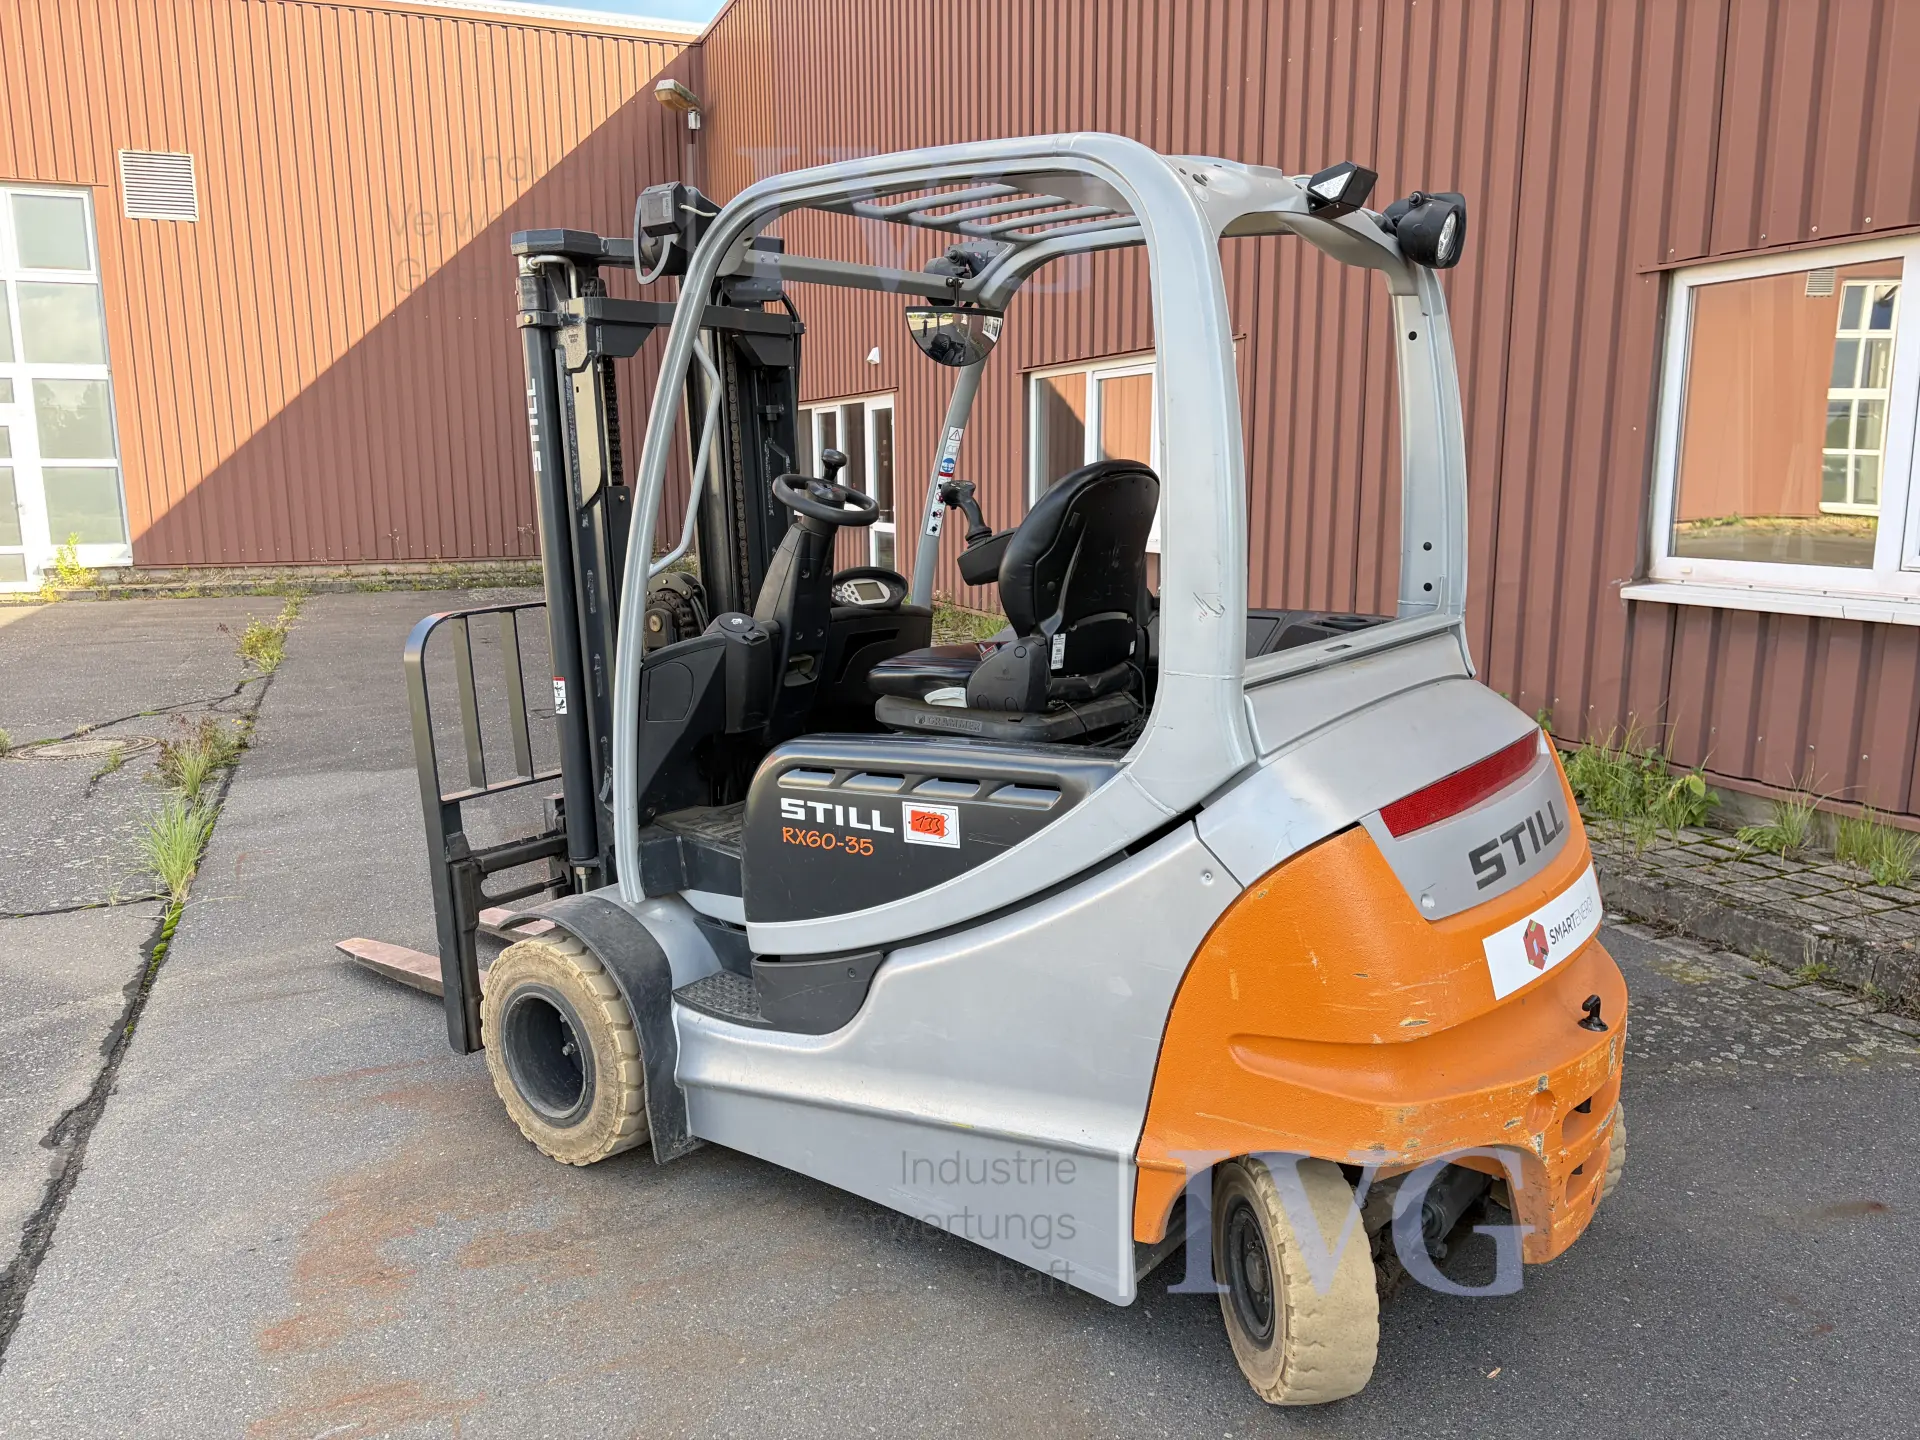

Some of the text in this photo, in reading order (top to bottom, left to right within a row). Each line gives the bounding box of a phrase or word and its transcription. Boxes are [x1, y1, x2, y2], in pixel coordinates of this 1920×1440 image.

[780, 797, 895, 834] STILL
[782, 826, 875, 856] RX60-35
[1467, 799, 1565, 891] STILL
